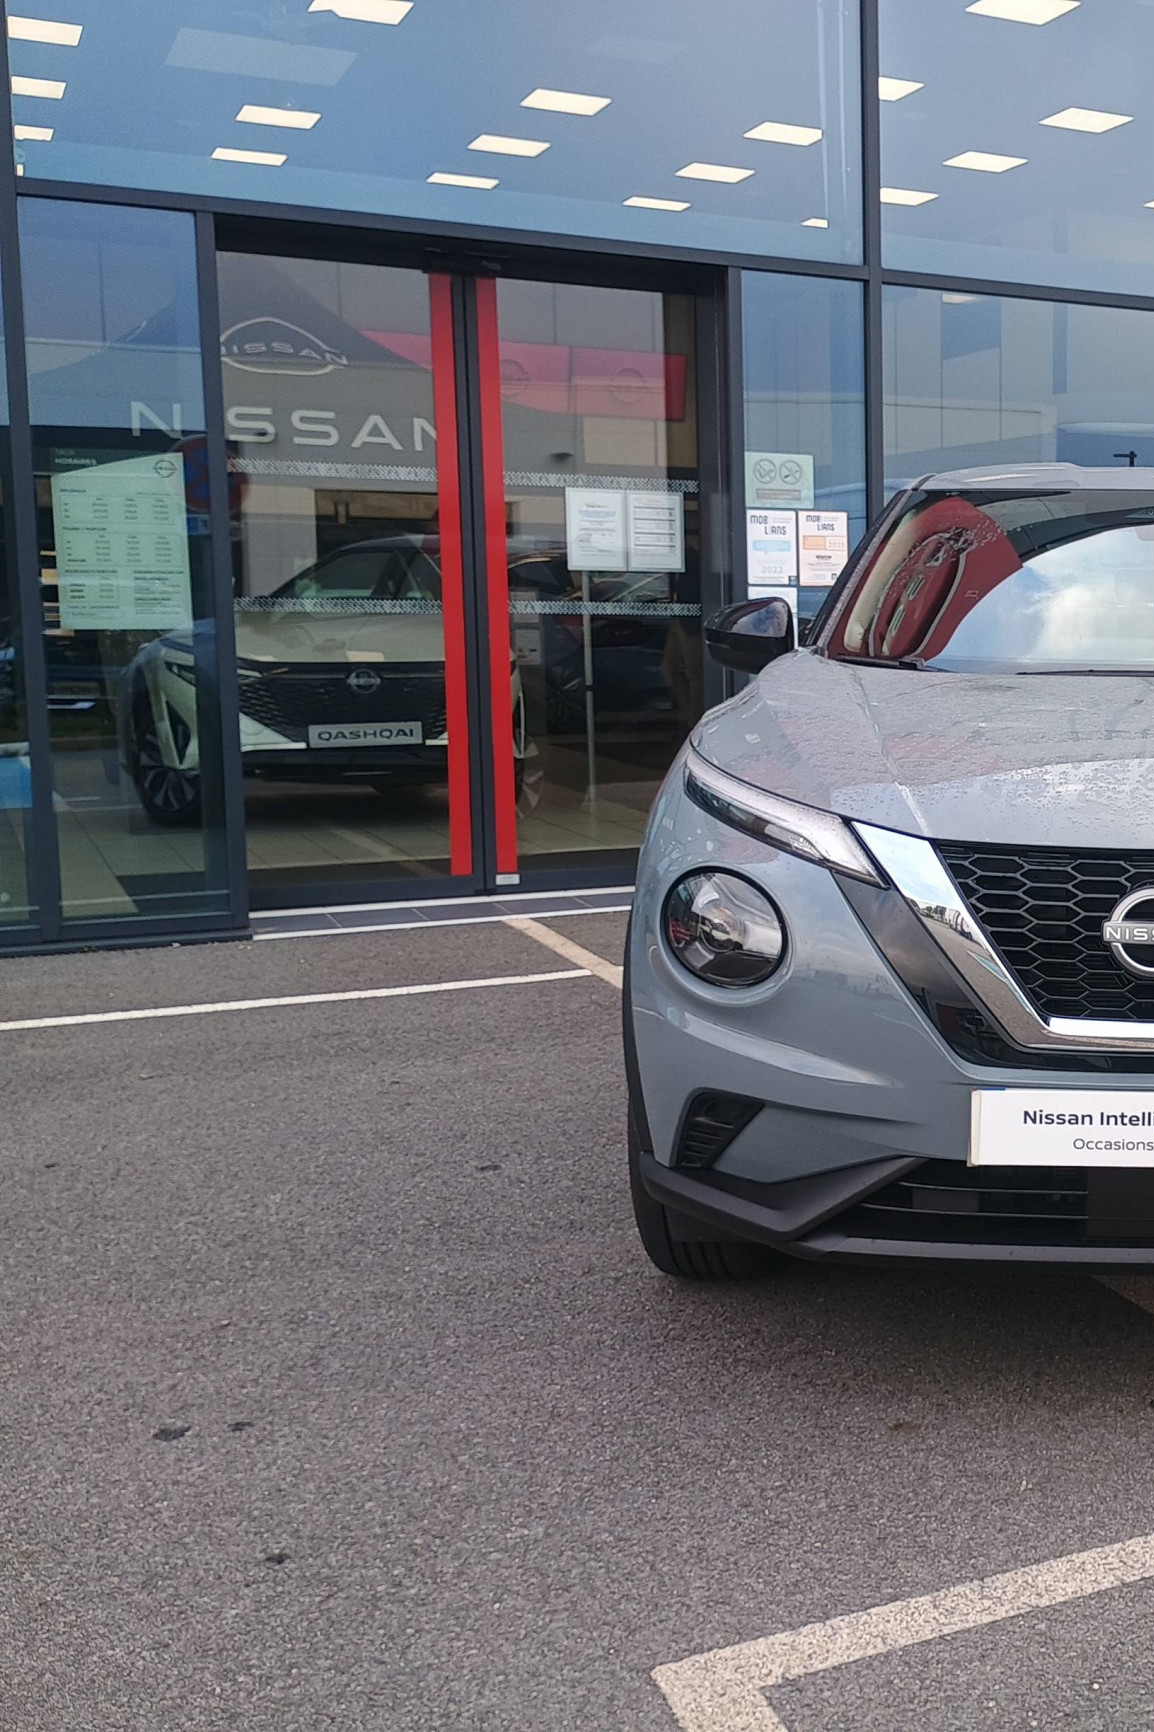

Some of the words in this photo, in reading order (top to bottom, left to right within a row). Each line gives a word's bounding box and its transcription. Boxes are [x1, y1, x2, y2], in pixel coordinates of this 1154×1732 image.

[130, 401, 437, 451] NSSA
[317, 728, 414, 741] QASHQAI
[1023, 1110, 1093, 1125] Nissan
[1073, 1138, 1154, 1151] Occasions
